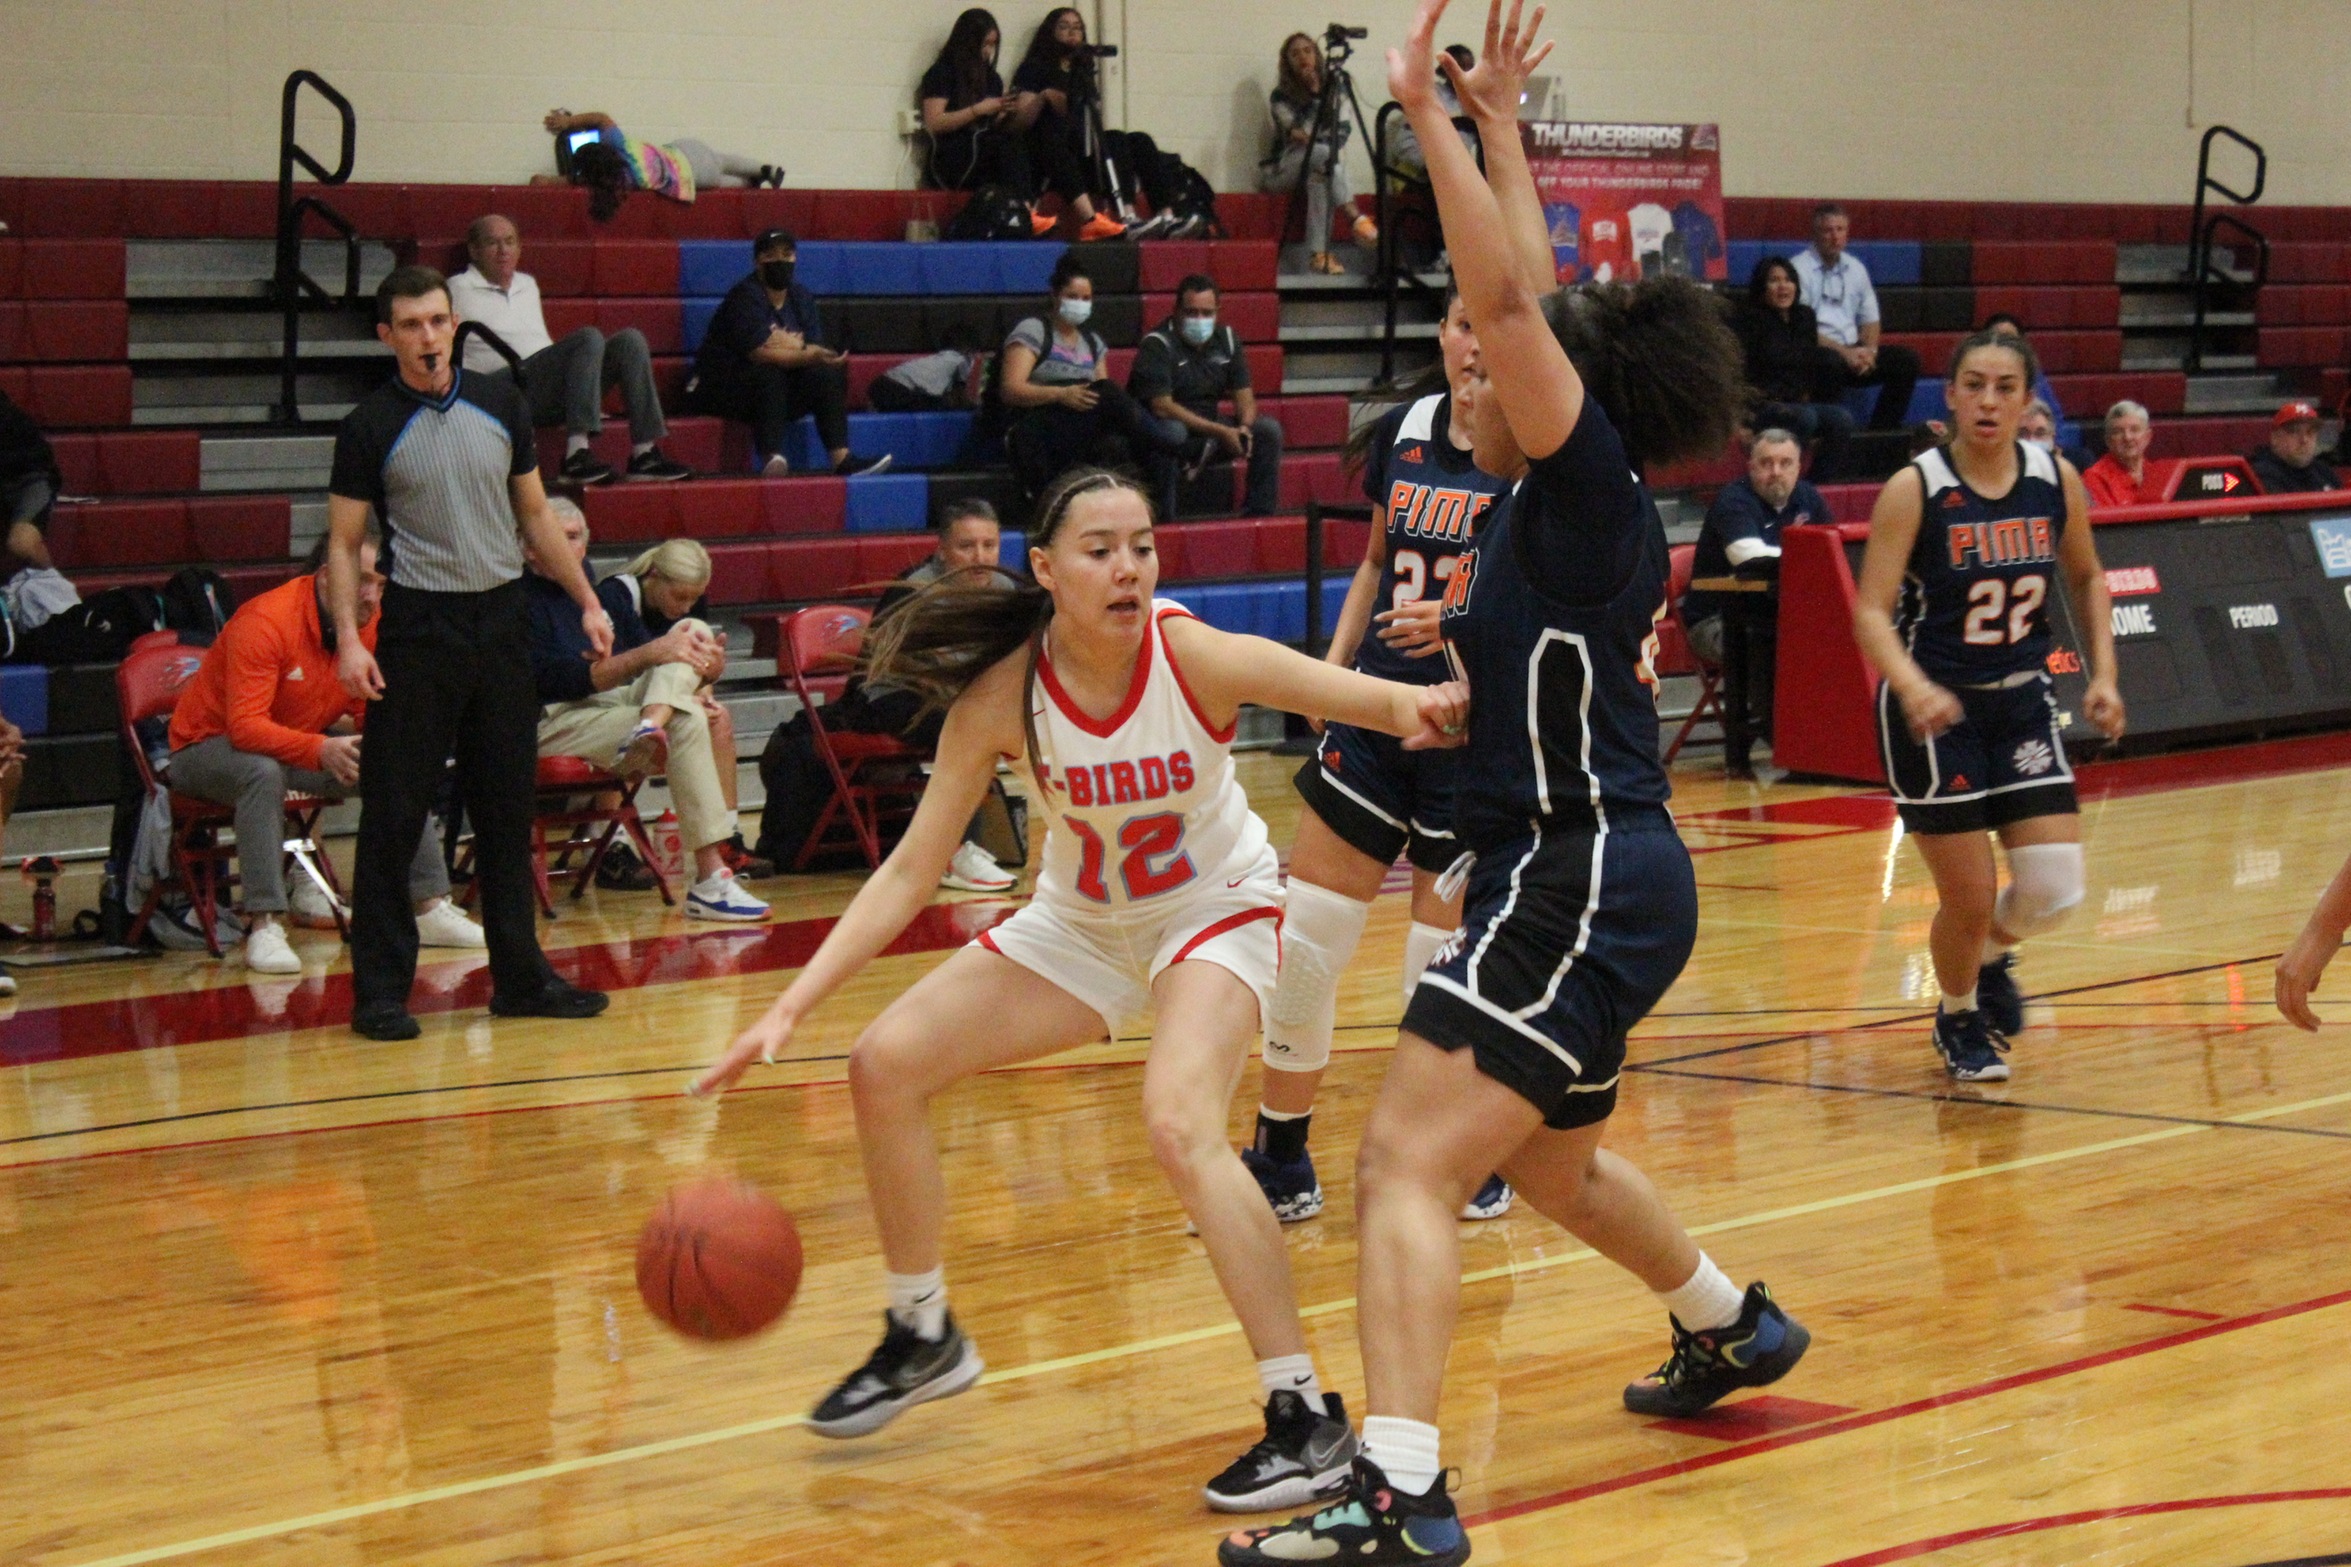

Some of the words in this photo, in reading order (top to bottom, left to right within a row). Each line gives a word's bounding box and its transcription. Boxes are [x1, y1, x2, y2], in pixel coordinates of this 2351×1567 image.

[1531, 122, 1684, 149] THUNDERBIRDS
[1560, 176, 1590, 188] YOUR
[1947, 517, 2056, 570] PIMA
[1963, 575, 2047, 645] 22
[2228, 603, 2279, 629] PERIOD
[1062, 810, 1198, 904] 12
